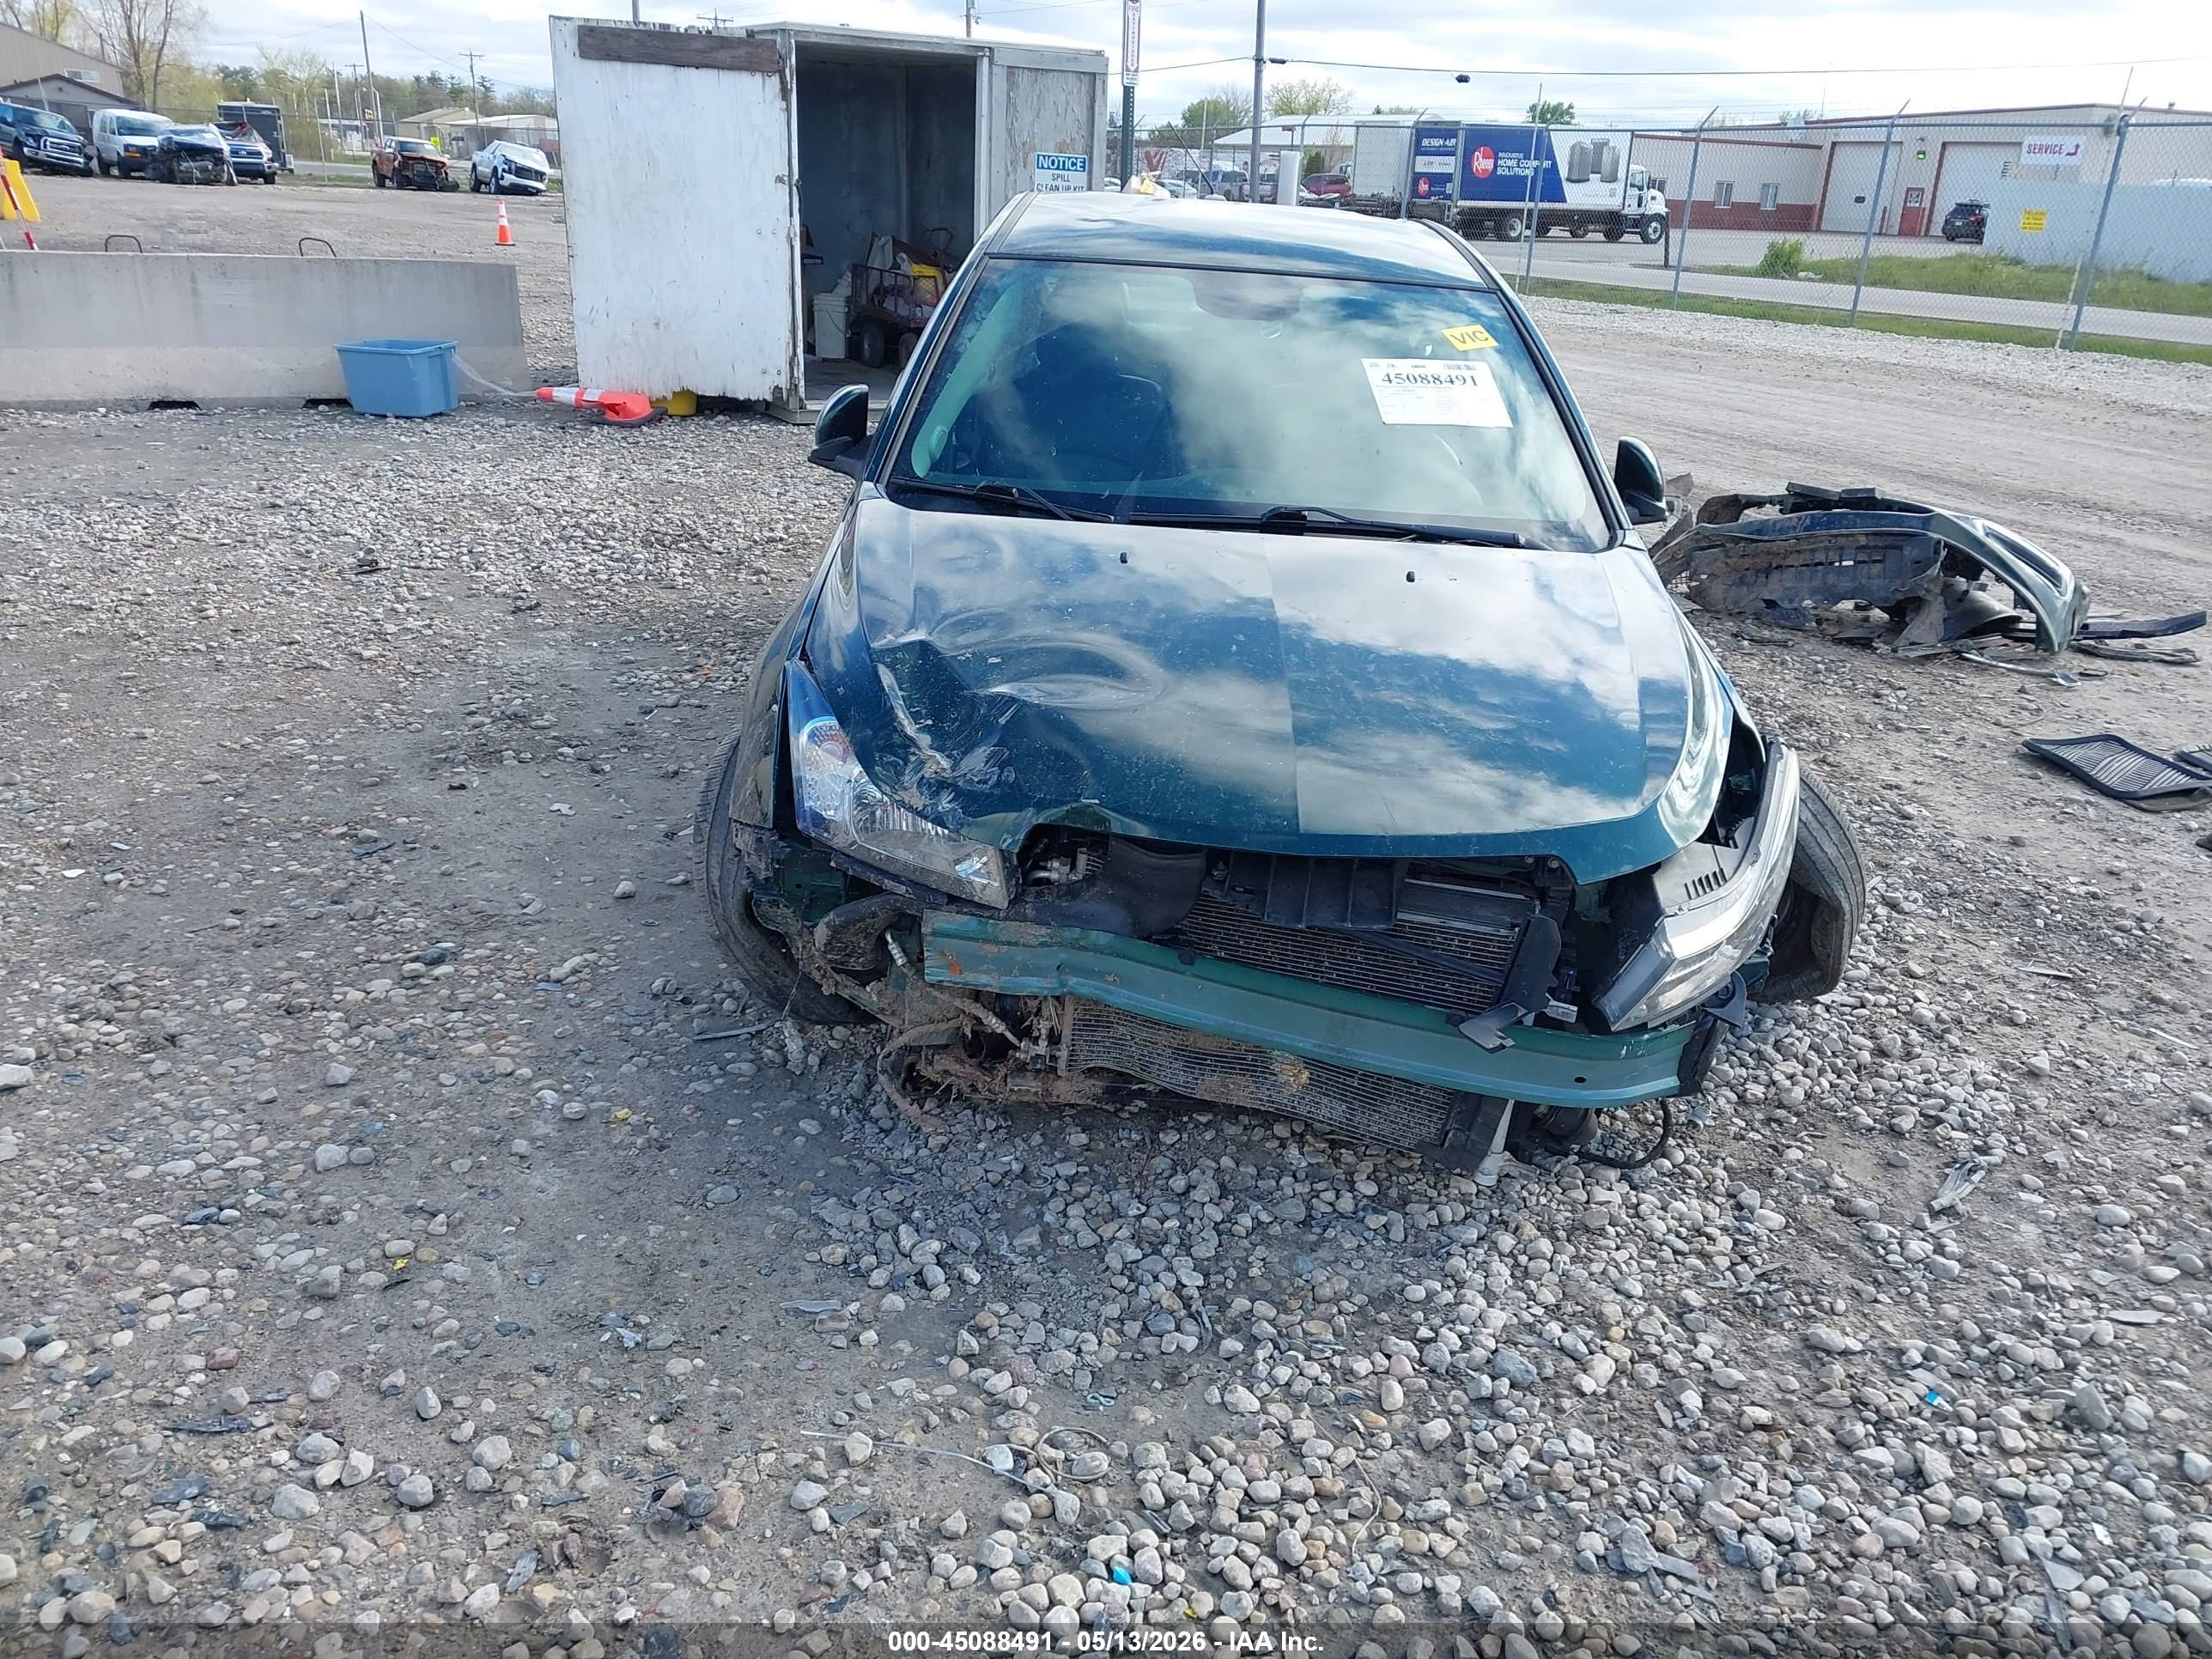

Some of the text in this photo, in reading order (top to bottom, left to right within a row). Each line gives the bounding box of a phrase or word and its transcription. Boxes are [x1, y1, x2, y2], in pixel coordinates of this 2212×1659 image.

[1421, 137, 1444, 146] DESIGN
[2027, 143, 2064, 155] SERVICE
[1038, 155, 1085, 171] NOTICE
[1474, 147, 1494, 173] Rheem
[1498, 159, 1518, 167] HOME
[1497, 167, 1534, 176] SOLUTIONS
[1051, 172, 1071, 183] SPILL
[1036, 183, 1060, 192] CLEAN
[1449, 330, 1489, 344] VIC
[1382, 372, 1478, 386] 45088491
